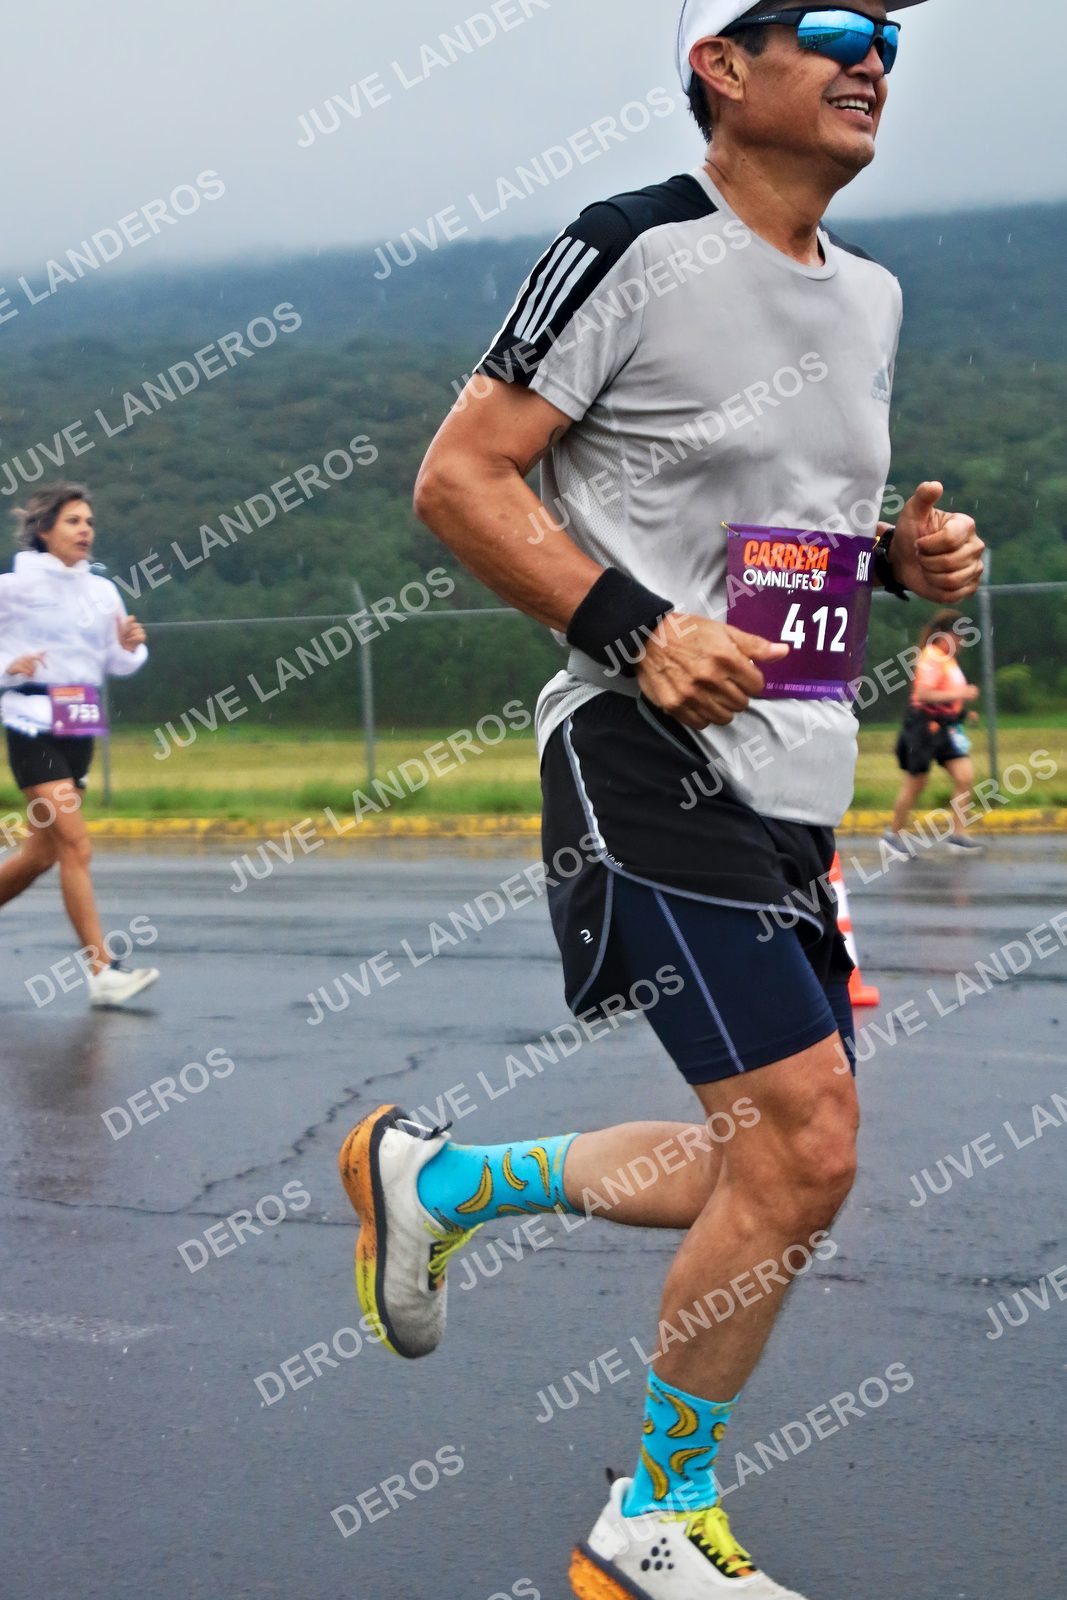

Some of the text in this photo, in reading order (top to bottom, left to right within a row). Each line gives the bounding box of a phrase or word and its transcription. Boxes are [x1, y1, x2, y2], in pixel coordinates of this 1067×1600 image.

[743, 540, 829, 571] CARRERA
[856, 550, 872, 582] 15K
[780, 603, 848, 652] 412
